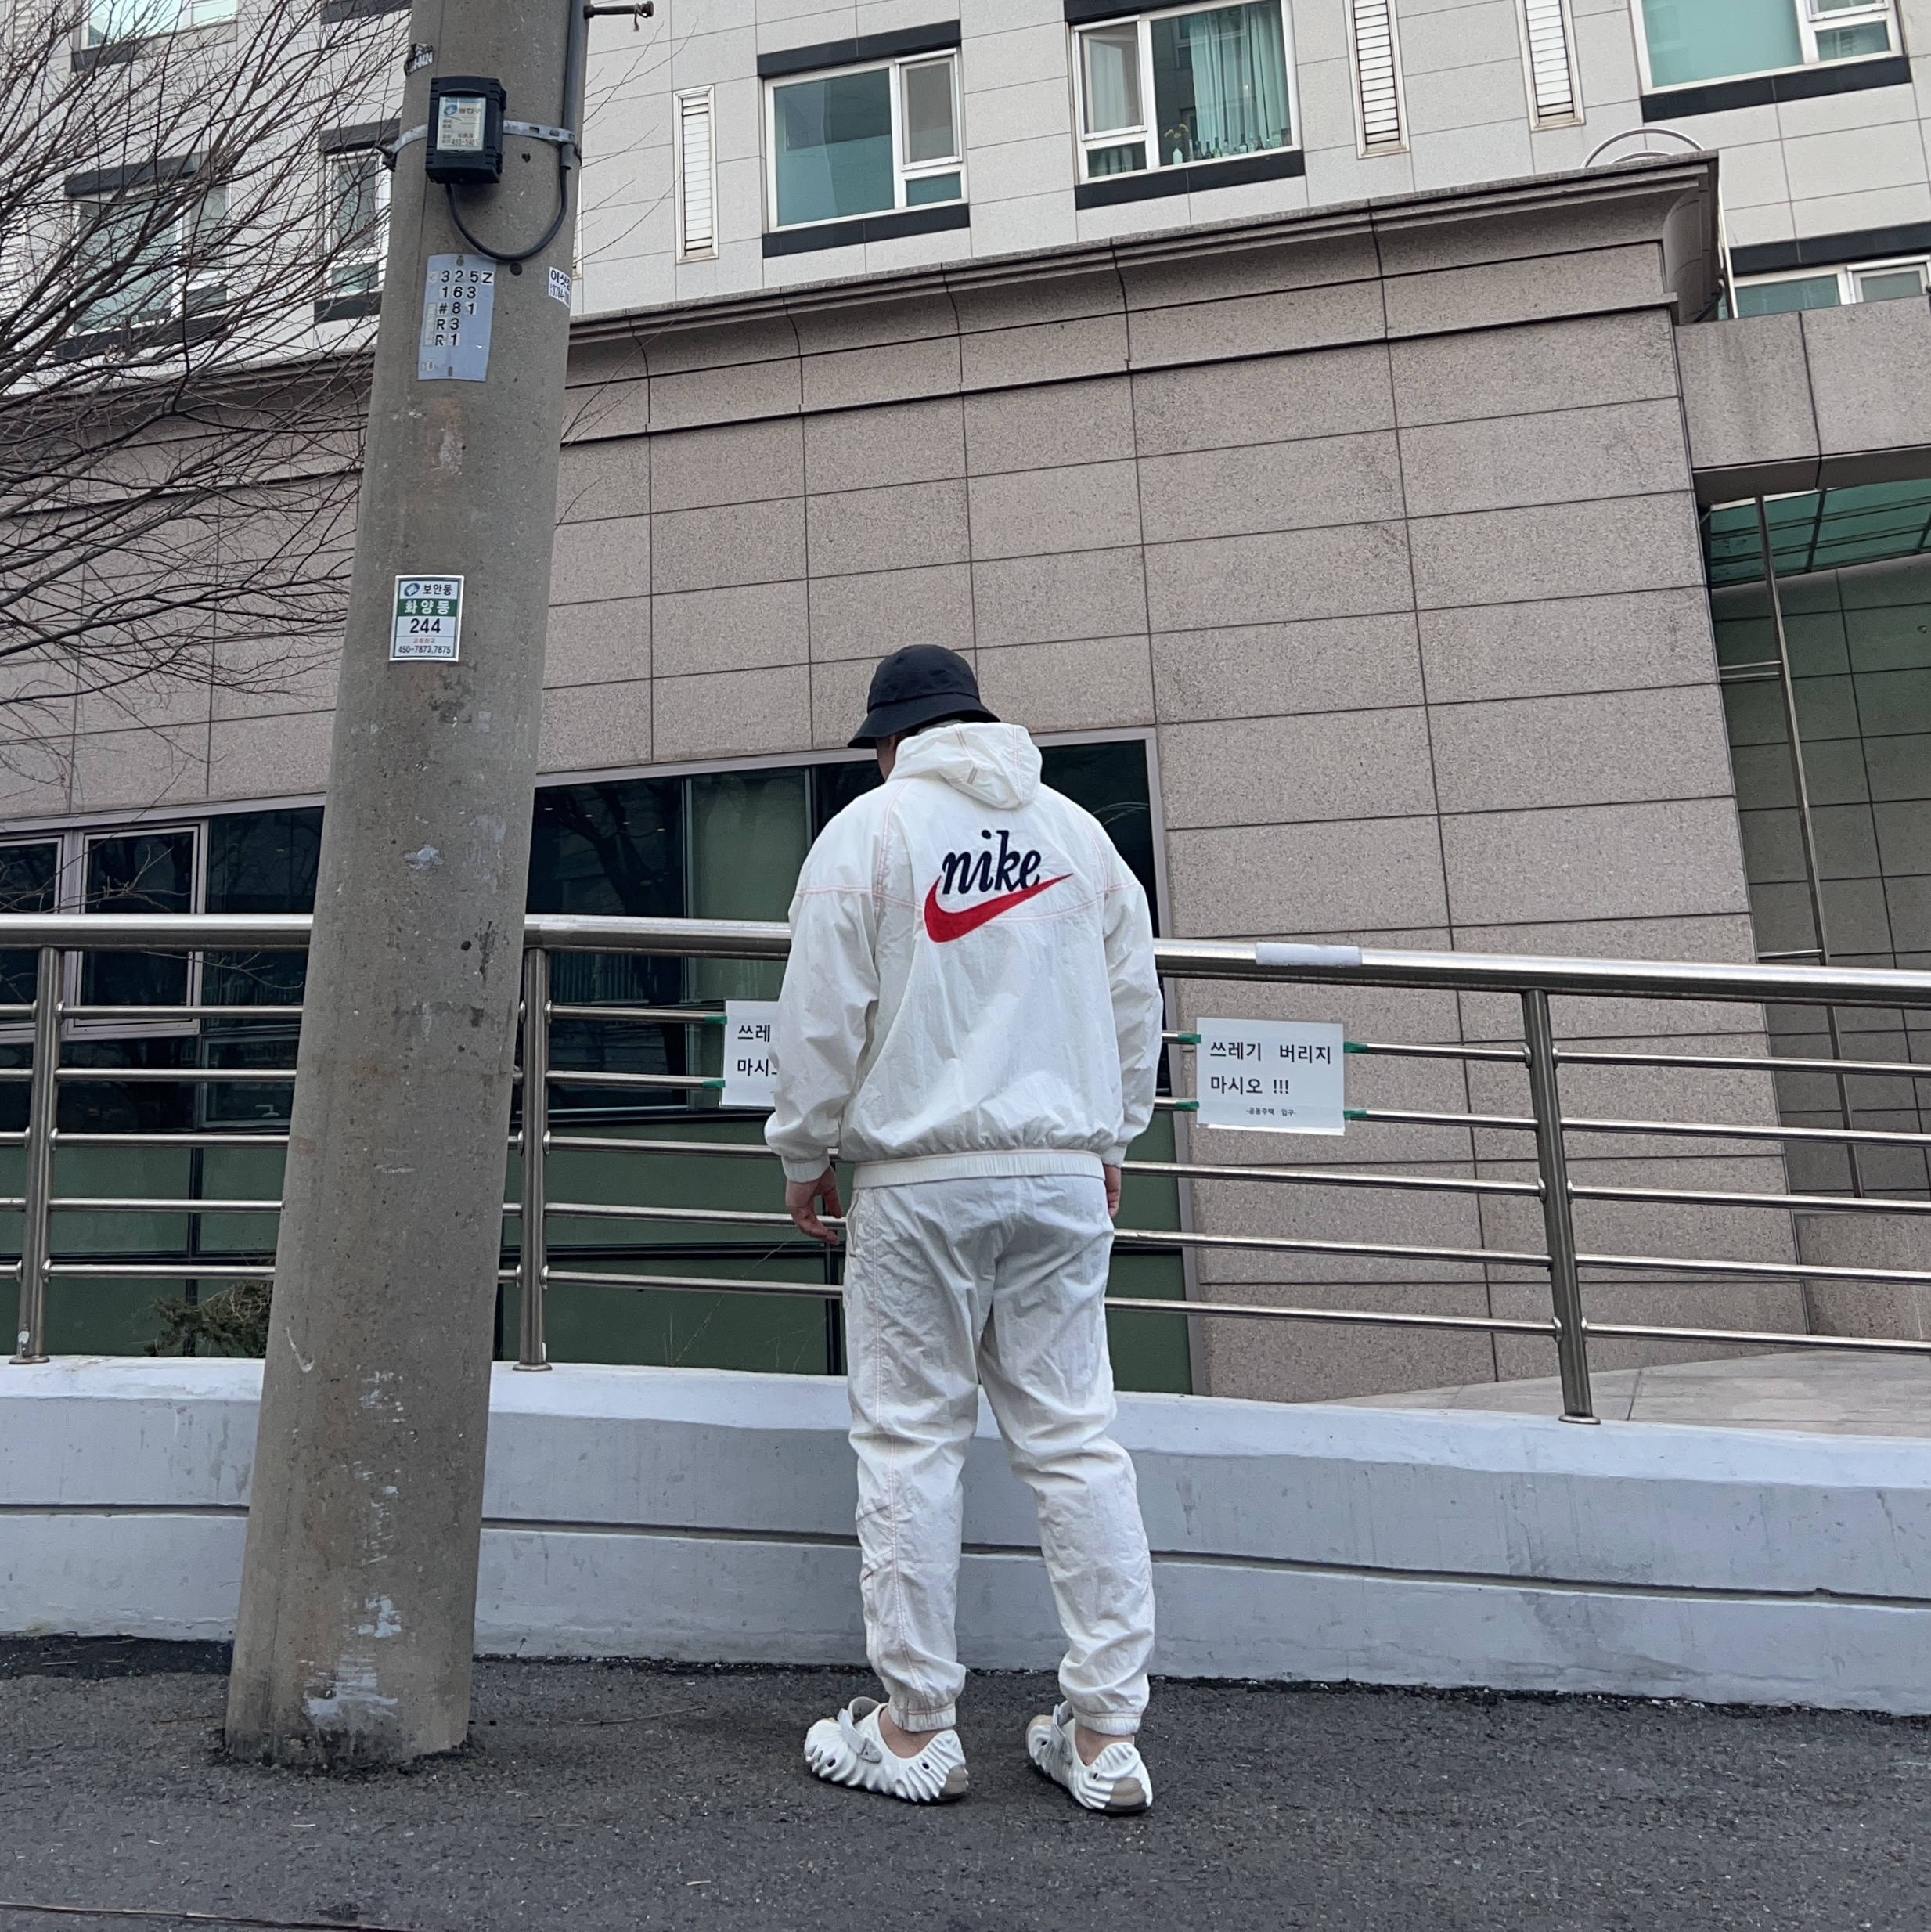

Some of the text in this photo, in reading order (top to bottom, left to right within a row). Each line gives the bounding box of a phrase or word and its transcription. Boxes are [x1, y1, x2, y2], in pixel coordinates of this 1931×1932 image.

[423, 584, 452, 596] 보안등
[404, 600, 450, 615] 화양동
[409, 618, 441, 633] 244
[942, 829, 1042, 895] nike
[738, 1024, 771, 1043] 쓰레
[1210, 1041, 1331, 1065] 쓰레기 버리지
[737, 1058, 777, 1077] 마시
[1210, 1076, 1263, 1094] 마시오
